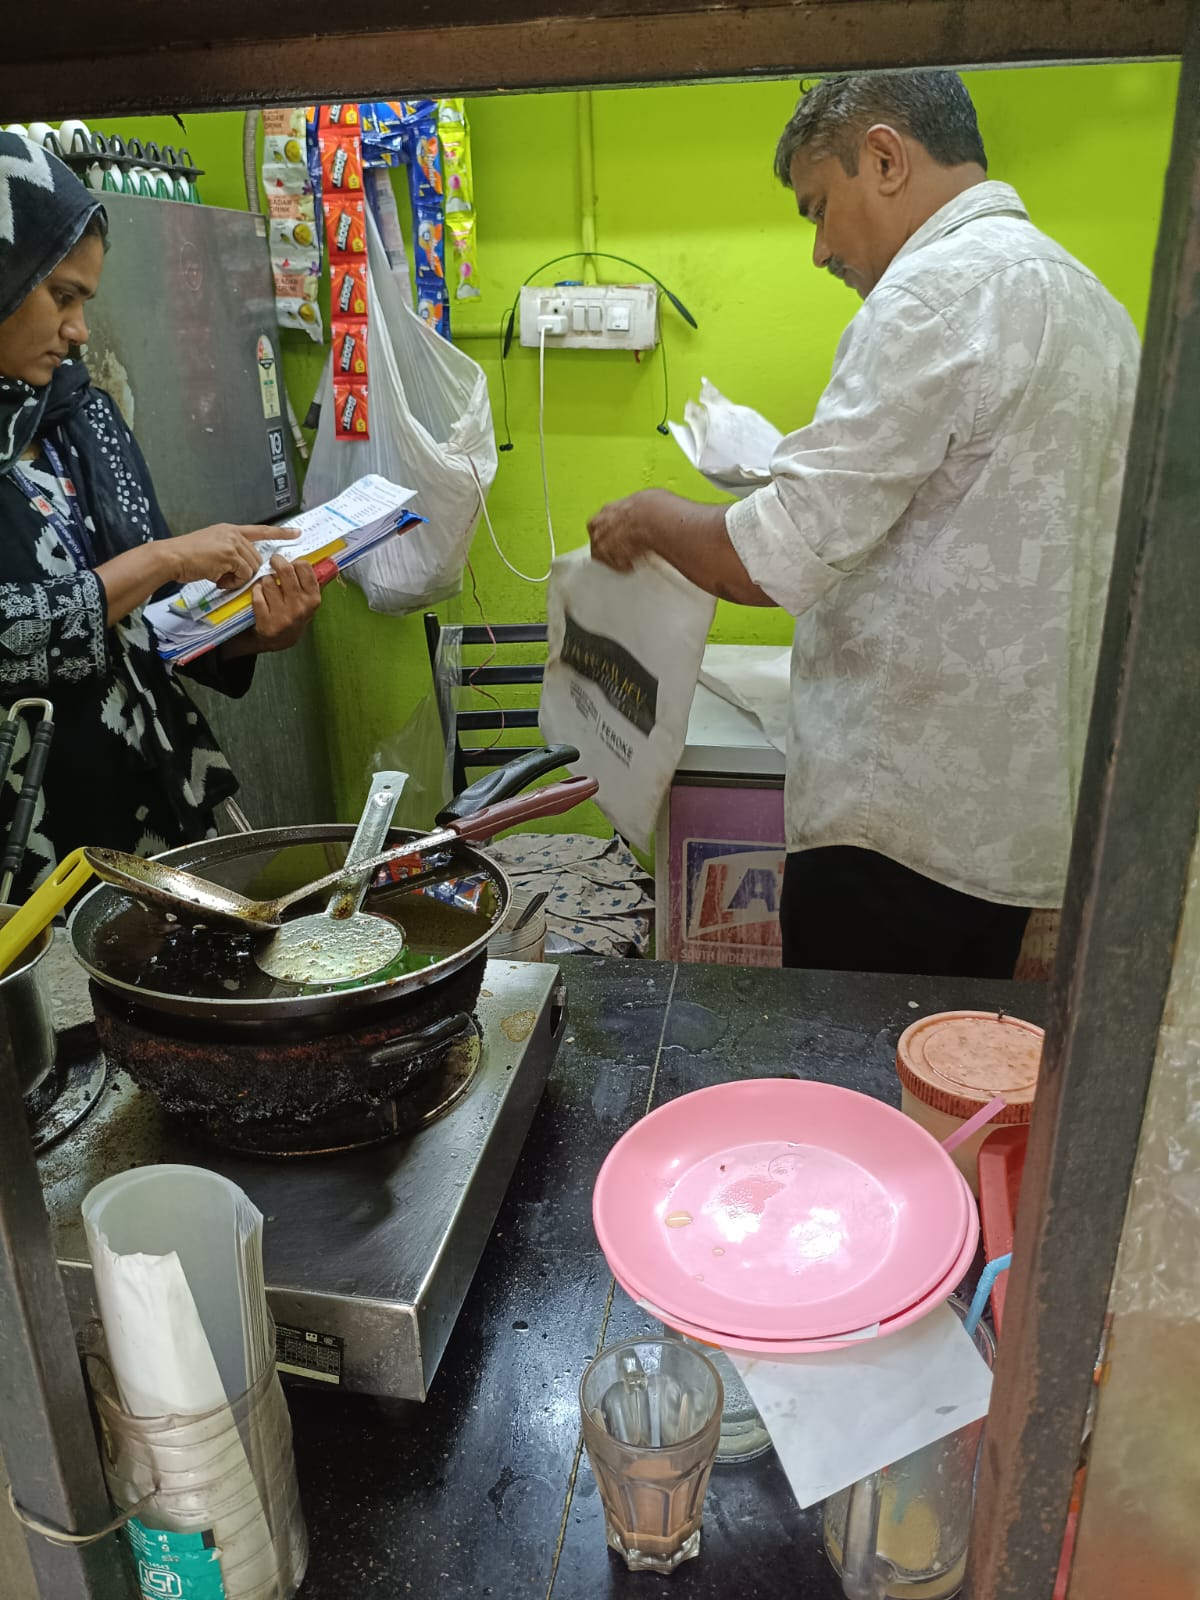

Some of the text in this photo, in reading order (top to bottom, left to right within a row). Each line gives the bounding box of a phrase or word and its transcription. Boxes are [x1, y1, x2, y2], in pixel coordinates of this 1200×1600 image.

[331, 149, 347, 188] BOOST
[336, 213, 352, 251] BOOST
[340, 275, 355, 312] BOOST
[341, 335, 356, 372] BOOST
[343, 395, 357, 431] BOOST
[699, 862, 783, 929] LA
